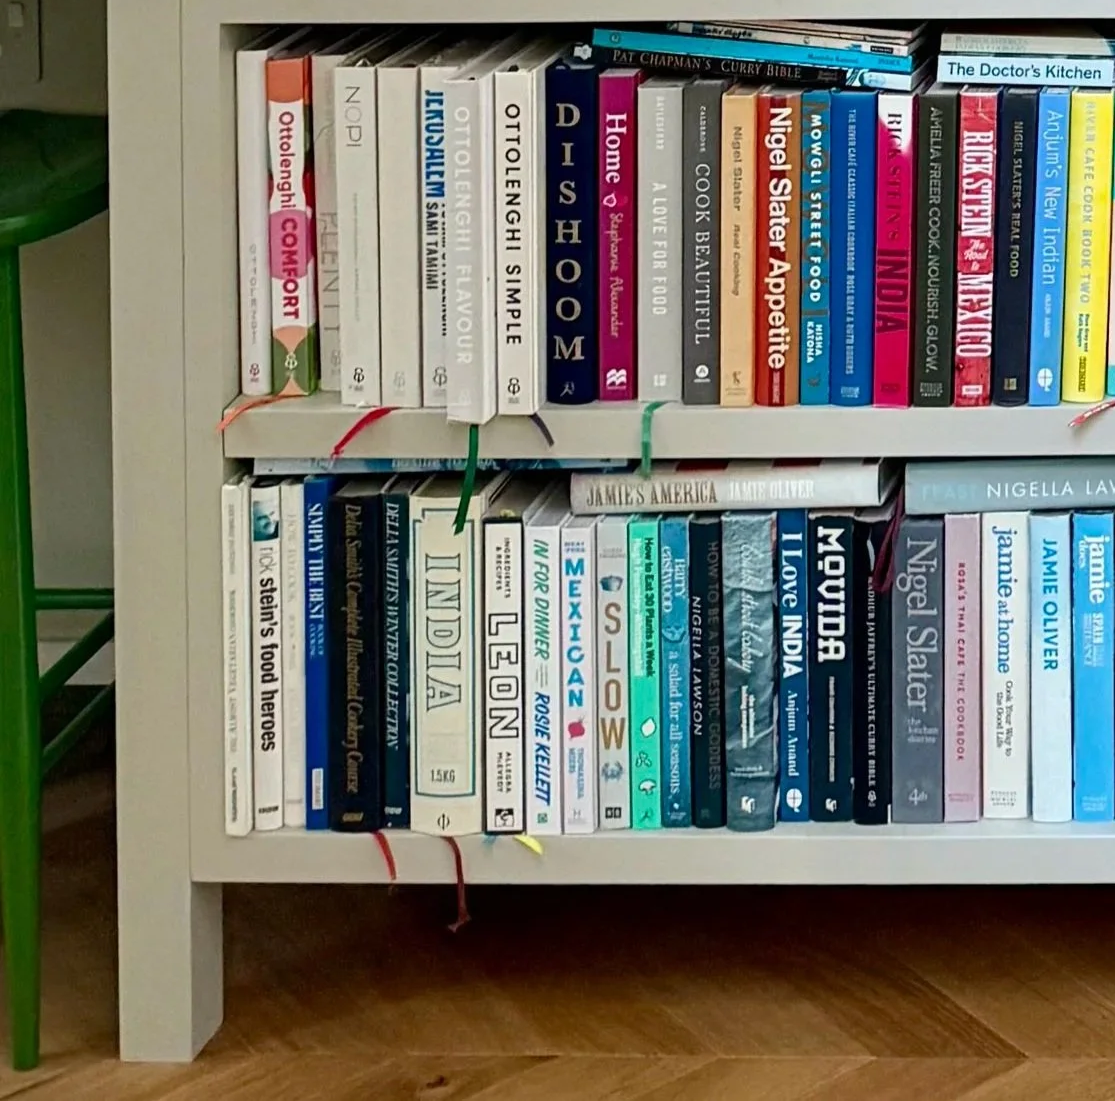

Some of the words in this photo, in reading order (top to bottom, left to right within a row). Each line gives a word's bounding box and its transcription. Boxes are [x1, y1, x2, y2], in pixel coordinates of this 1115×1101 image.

[611, 49, 635, 63] PAT
[639, 51, 712, 72] CHAPMAN'S
[720, 60, 761, 75] CURRY
[764, 63, 801, 79] BIBLE
[947, 62, 974, 76] The
[980, 62, 1040, 78] Doctor's
[1045, 65, 1101, 79] Kitchen
[344, 85, 362, 147] NOPI
[764, 107, 792, 171] Nigel
[886, 113, 902, 157] RICK
[929, 107, 942, 160] AMELIA
[1013, 121, 1023, 155] NIGEL
[1085, 101, 1097, 142] RIVER
[275, 111, 296, 208] Ottolenghi
[425, 89, 445, 198] JERUSALEM
[605, 112, 627, 183] Home
[731, 126, 743, 163] Nigel
[810, 114, 822, 185] MOWGLI
[962, 130, 995, 176] RICK
[1042, 110, 1063, 178] Anjum's
[454, 106, 472, 252] OTTOLENGHI
[504, 103, 521, 251] OTTOLENGHI
[652, 182, 668, 192] A
[695, 163, 710, 224] COOK
[732, 167, 743, 211] Slater
[928, 162, 941, 205] FREER
[1011, 158, 1022, 209] SLATER'S
[425, 202, 439, 237] SAMI
[652, 197, 668, 235] LOVE
[768, 177, 792, 252] Slater
[810, 192, 822, 247] STREET
[887, 164, 902, 240] STEIN'S
[961, 177, 993, 237] STEIN
[1043, 186, 1061, 219] New
[1082, 185, 1095, 223] COOK
[555, 102, 585, 360] DISHOOM
[605, 212, 624, 272] Stephanie
[1010, 212, 1021, 241] REAL
[1081, 228, 1093, 268] BOOK
[280, 218, 300, 320] COMFORT
[425, 241, 439, 290] TAMIMI
[652, 241, 668, 269] FOR
[1009, 245, 1020, 277] FOOD
[1041, 227, 1060, 285] Indian
[652, 277, 668, 315] FOOD
[695, 232, 711, 344] BEAUTIFUL
[809, 256, 822, 302] FOOD
[876, 248, 909, 335] INDIA
[1080, 273, 1092, 304] TWO
[455, 264, 474, 365] FLAVOUR
[505, 264, 522, 345] SIMPLE
[609, 276, 624, 338] Alexander
[764, 257, 791, 369] Appetite
[956, 271, 994, 357] MEXICO
[586, 483, 645, 507] JAMIE'S
[650, 480, 718, 505] AMERICA
[728, 480, 767, 500] JAMIE
[770, 478, 814, 499] OLIVER
[986, 480, 1074, 500] NIGELLA
[308, 502, 324, 552] SIMPLY
[345, 504, 360, 536] Delia
[385, 502, 399, 544] DELIA
[782, 532, 802, 541] I
[258, 546, 277, 574] rick
[308, 558, 324, 585] THE
[345, 538, 361, 578] Smith's
[534, 539, 549, 559] IN
[644, 537, 654, 559] How
[644, 560, 654, 572] to
[706, 541, 719, 578] HOW
[992, 526, 1018, 598] jamie
[1042, 537, 1058, 594] JAMIE
[1078, 539, 1088, 568] does
[1083, 535, 1111, 604] jamie
[385, 547, 399, 602] SMITH'S
[534, 561, 549, 595] FOR
[644, 574, 654, 591] Eat
[706, 582, 719, 603] TO
[782, 549, 802, 607] Love
[817, 525, 845, 663] MOVIDA
[896, 537, 938, 615] Nigel
[957, 562, 968, 601] ROSA'S
[259, 577, 279, 638] stein's
[309, 587, 324, 621] BEST
[341, 582, 361, 635] Complete
[644, 593, 654, 607] 30
[707, 606, 719, 625] BE
[957, 606, 966, 633] THAI
[998, 600, 1009, 615] at
[385, 604, 400, 661] WINTER
[424, 553, 461, 712] INDIA
[534, 597, 550, 660] DINNER
[565, 558, 585, 707] MEXICAN
[644, 608, 654, 640] Plants
[690, 596, 702, 660] NIGELLA
[707, 629, 719, 641] A
[783, 614, 803, 678] INDIA
[865, 621, 876, 671] JAFFREY'S
[997, 618, 1014, 674] home
[1043, 601, 1059, 671] OLIVER
[1092, 612, 1105, 644] SPAIN
[259, 643, 279, 684] food
[346, 637, 363, 700] Illustrated
[488, 612, 519, 739] LEON
[600, 601, 626, 751] SLOW
[645, 649, 655, 678] Week
[669, 651, 678, 660] a
[906, 626, 939, 712] Slater
[669, 662, 681, 698] salad
[692, 667, 703, 736] LAWSON
[707, 645, 720, 717] DOMESTIC
[867, 672, 876, 722] ULTIMATE
[1004, 680, 1013, 702] Cook
[259, 689, 279, 752] heroes
[342, 701, 362, 749] Cookery
[385, 662, 399, 751] COLLECTION
[533, 691, 550, 741] ROSIE
[669, 701, 682, 720] for
[785, 690, 799, 732] Anjum
[956, 698, 965, 761] COOKBOOK
[996, 707, 1004, 728] Good
[1004, 705, 1013, 725] Your
[669, 722, 682, 741] all
[867, 723, 876, 757] CURRY
[346, 750, 362, 793] Course
[534, 742, 551, 806] KELLETT
[708, 722, 721, 790] GODDESS
[787, 734, 799, 777] Anand
[867, 758, 876, 787] BIBLE
